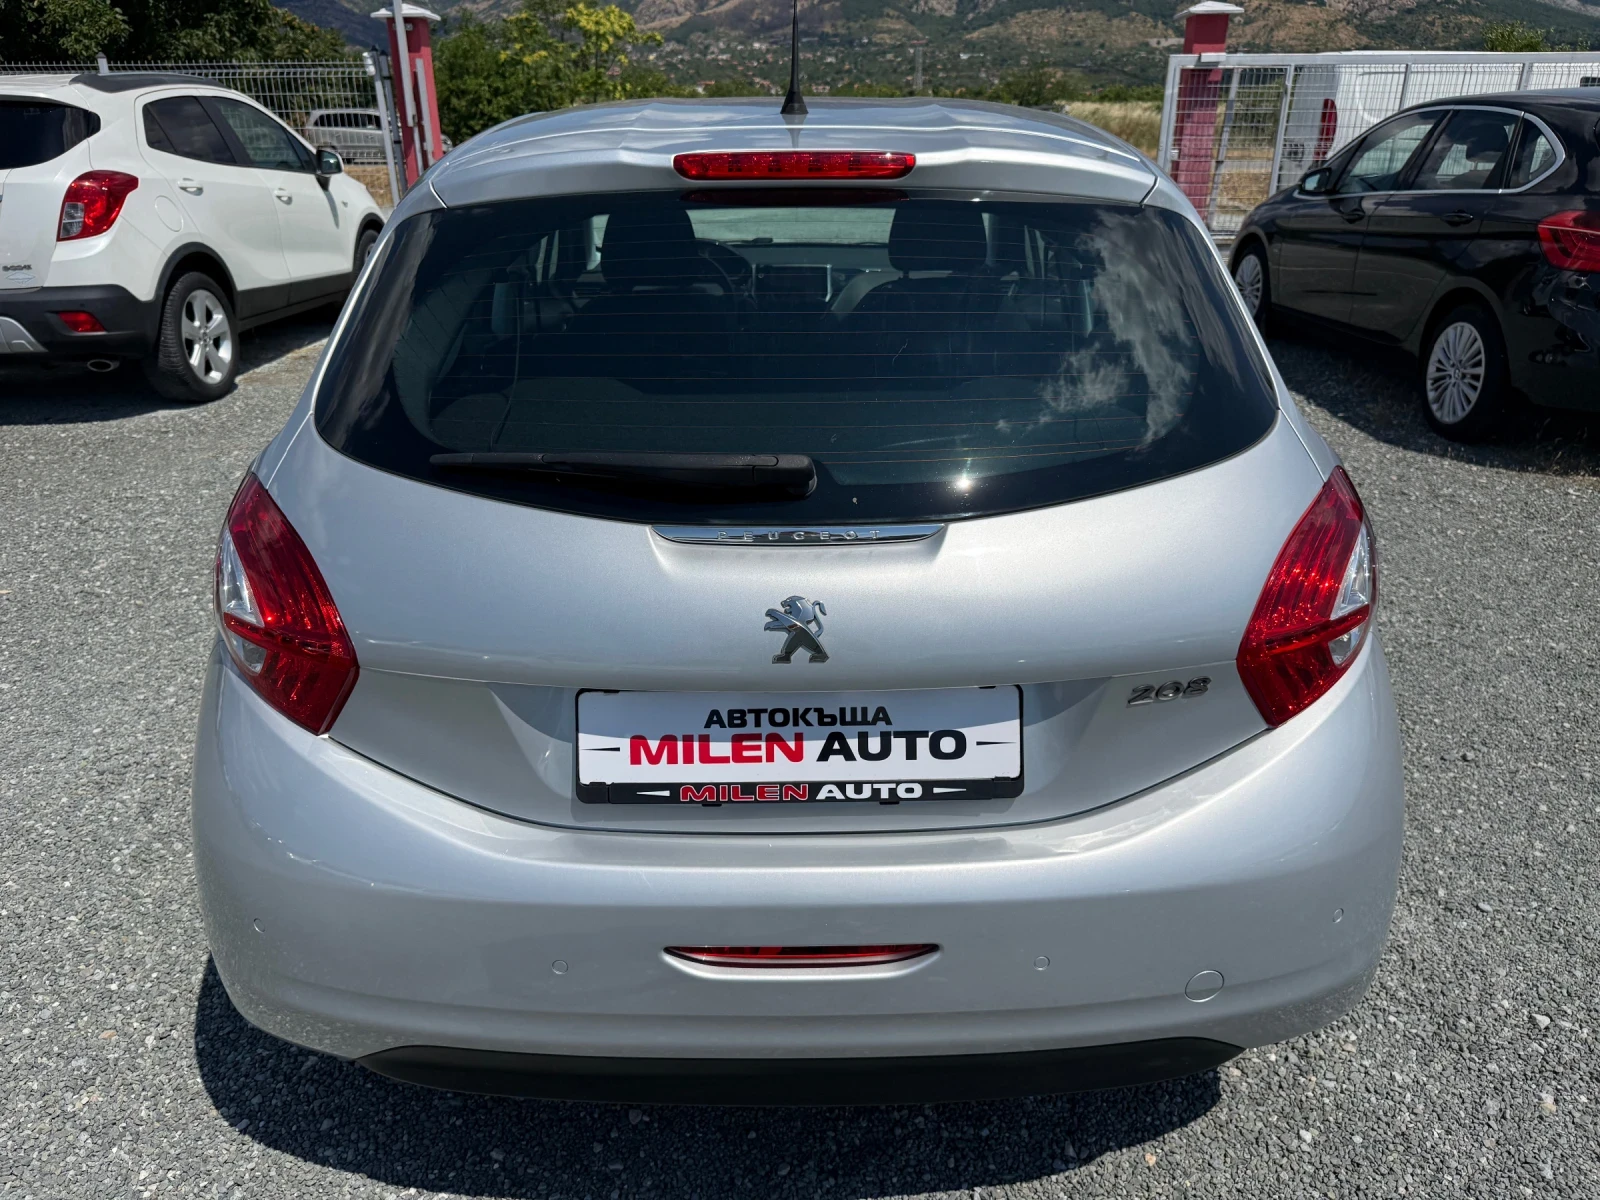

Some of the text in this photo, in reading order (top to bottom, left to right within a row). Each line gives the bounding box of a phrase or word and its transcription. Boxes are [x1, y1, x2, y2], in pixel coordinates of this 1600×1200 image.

[717, 530, 880, 541] PEUGEOT
[1127, 676, 1211, 707] 208
[629, 730, 967, 766] MILEN AUTO
[679, 783, 923, 802] MILEN AUTO
